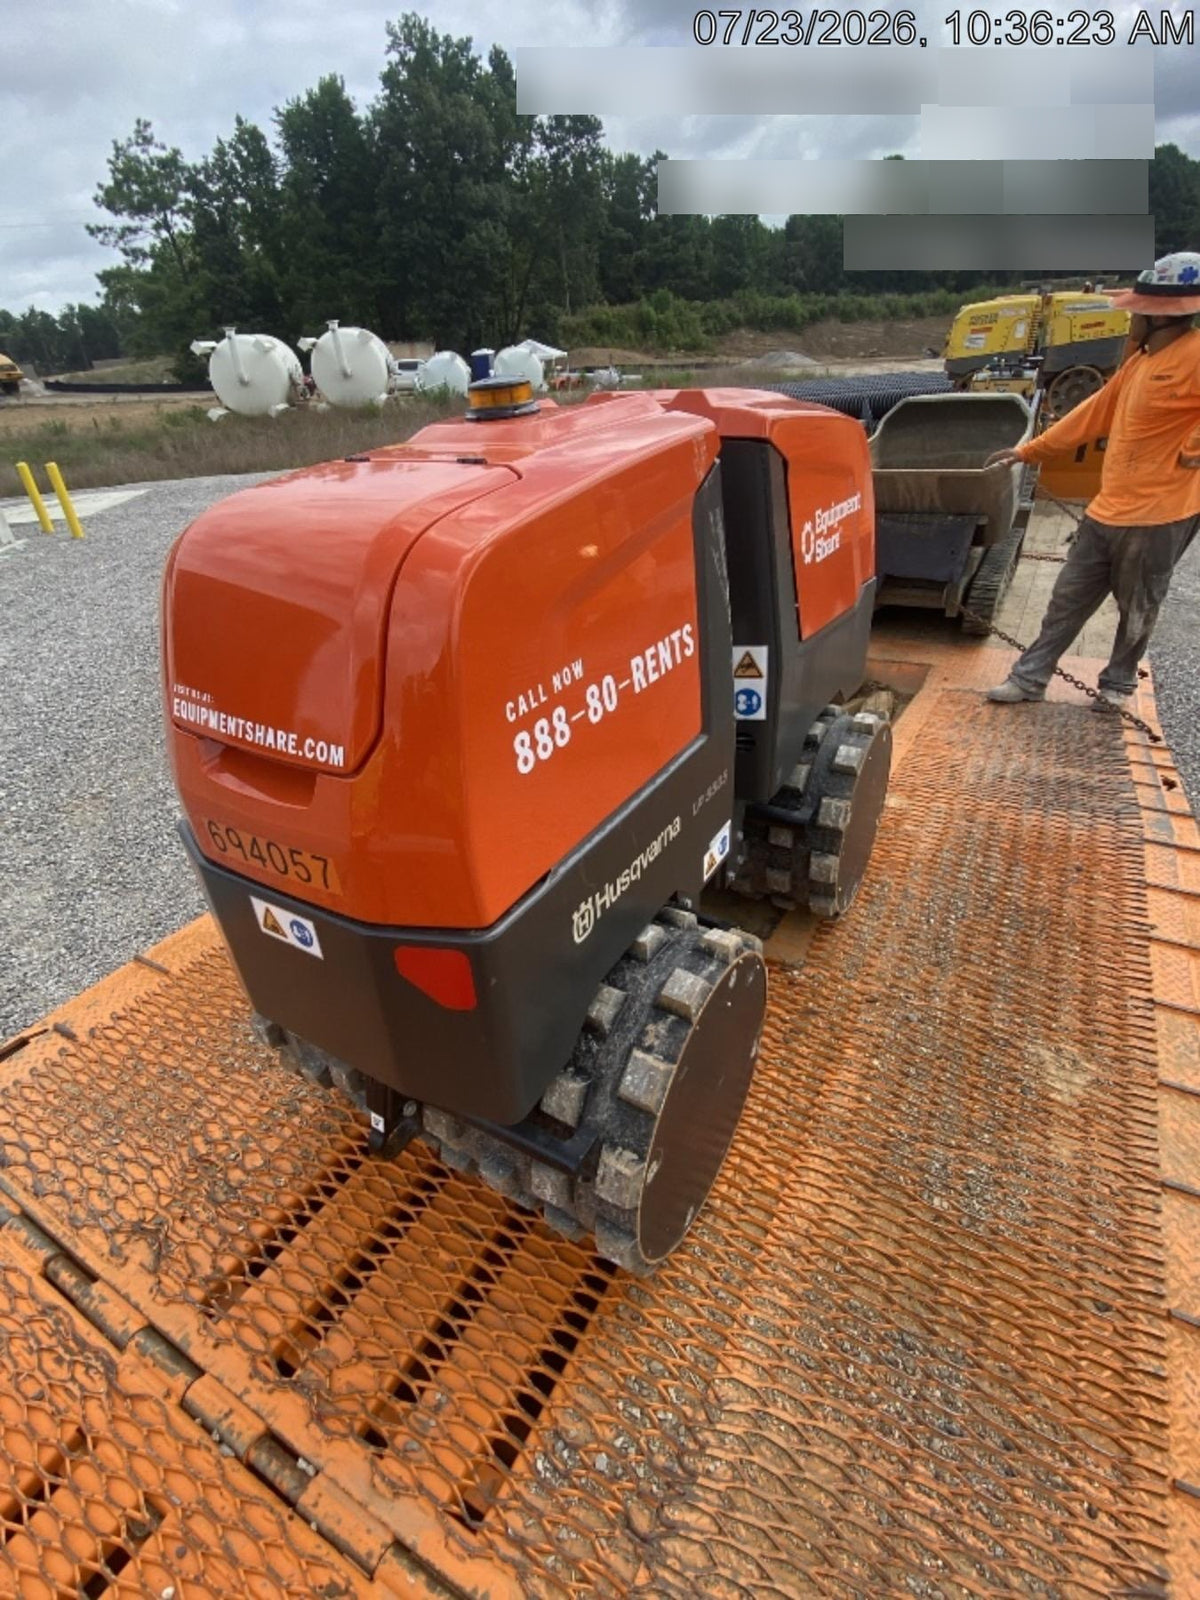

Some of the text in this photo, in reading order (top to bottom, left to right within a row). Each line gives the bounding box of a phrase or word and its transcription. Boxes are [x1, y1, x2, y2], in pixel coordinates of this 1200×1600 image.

[505, 658, 585, 722] CALL NOW
[513, 623, 695, 774] 888-80-RENTS
[173, 698, 345, 767] EQUIPMENTSHARE.COM
[207, 820, 329, 890] 694057
[595, 815, 681, 919] Husqvarna
